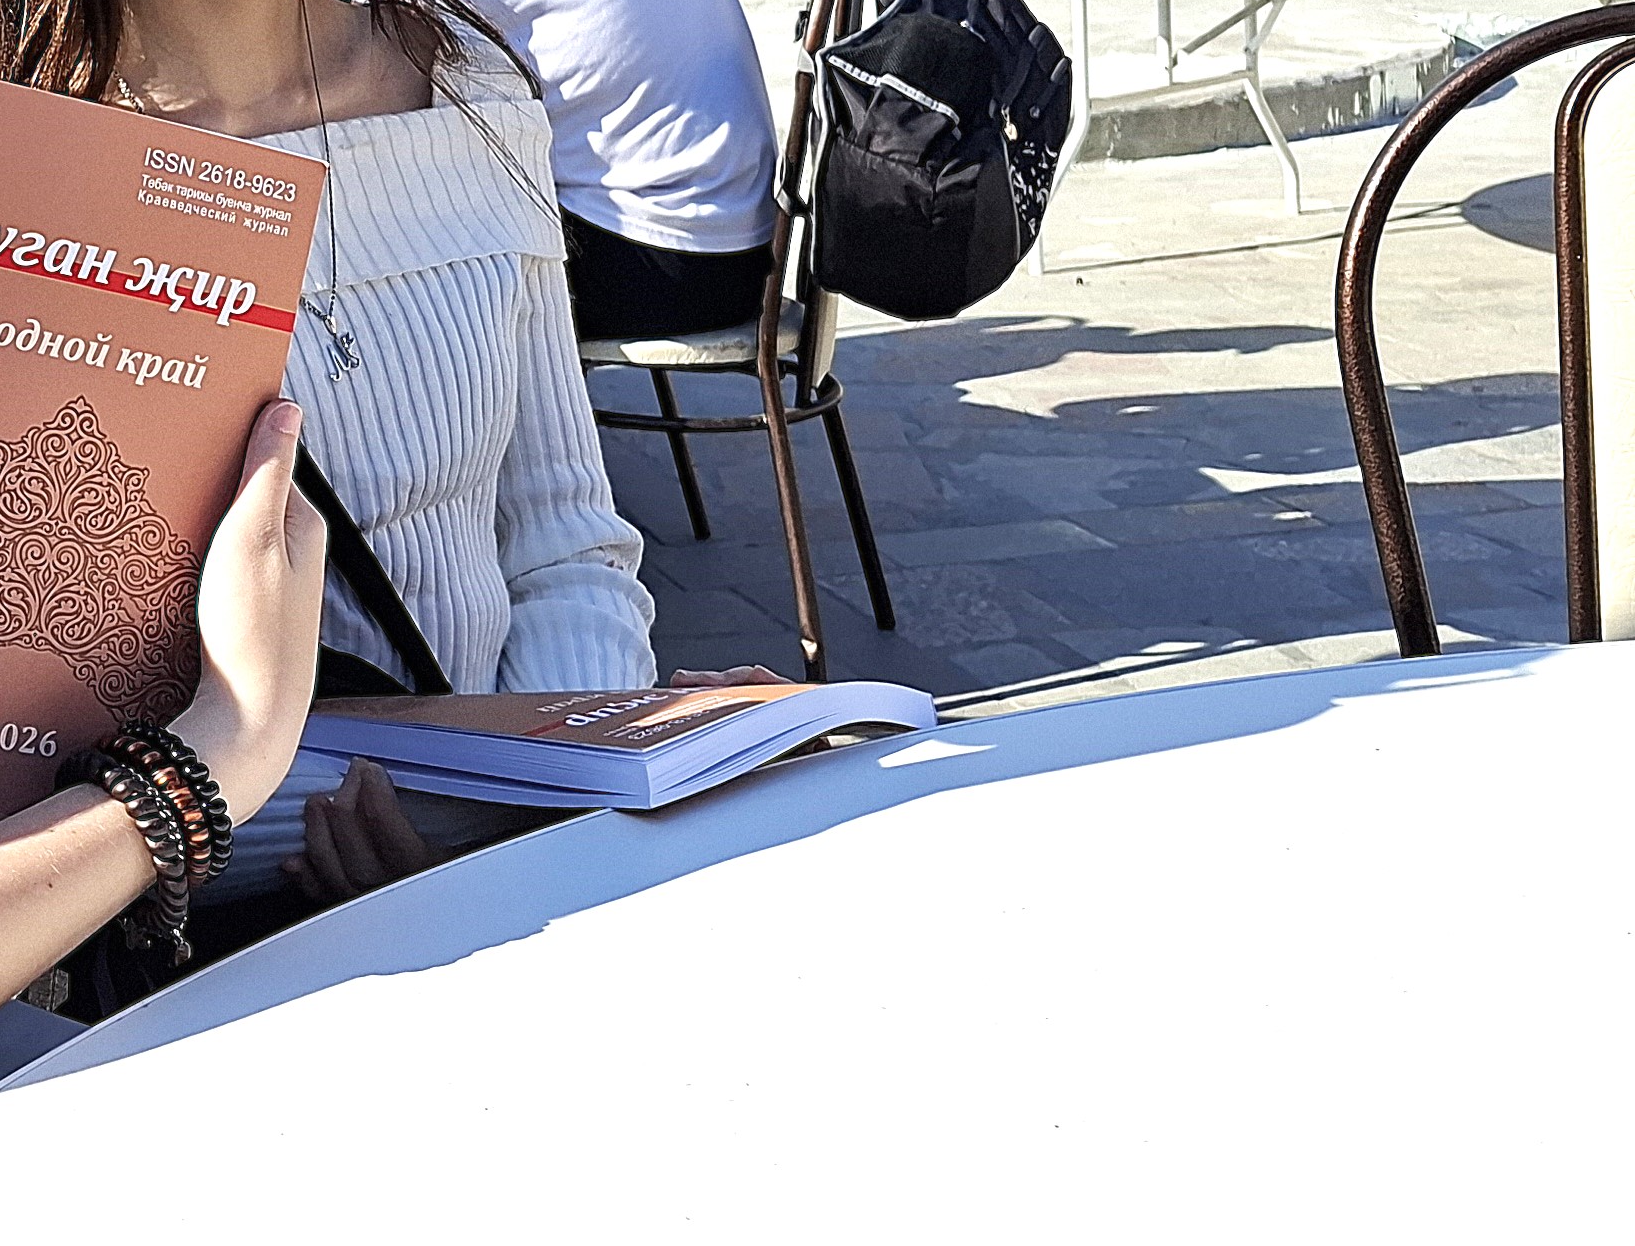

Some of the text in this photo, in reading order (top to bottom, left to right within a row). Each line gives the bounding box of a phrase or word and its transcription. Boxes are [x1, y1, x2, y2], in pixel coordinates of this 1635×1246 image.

[141, 174, 292, 223] Төбәк тарихы буенча журнал
[144, 147, 297, 202] ISSN 2618-9623
[137, 189, 289, 237] Краеведческий журнал
[125, 257, 257, 327] җир
[116, 347, 210, 389] край
